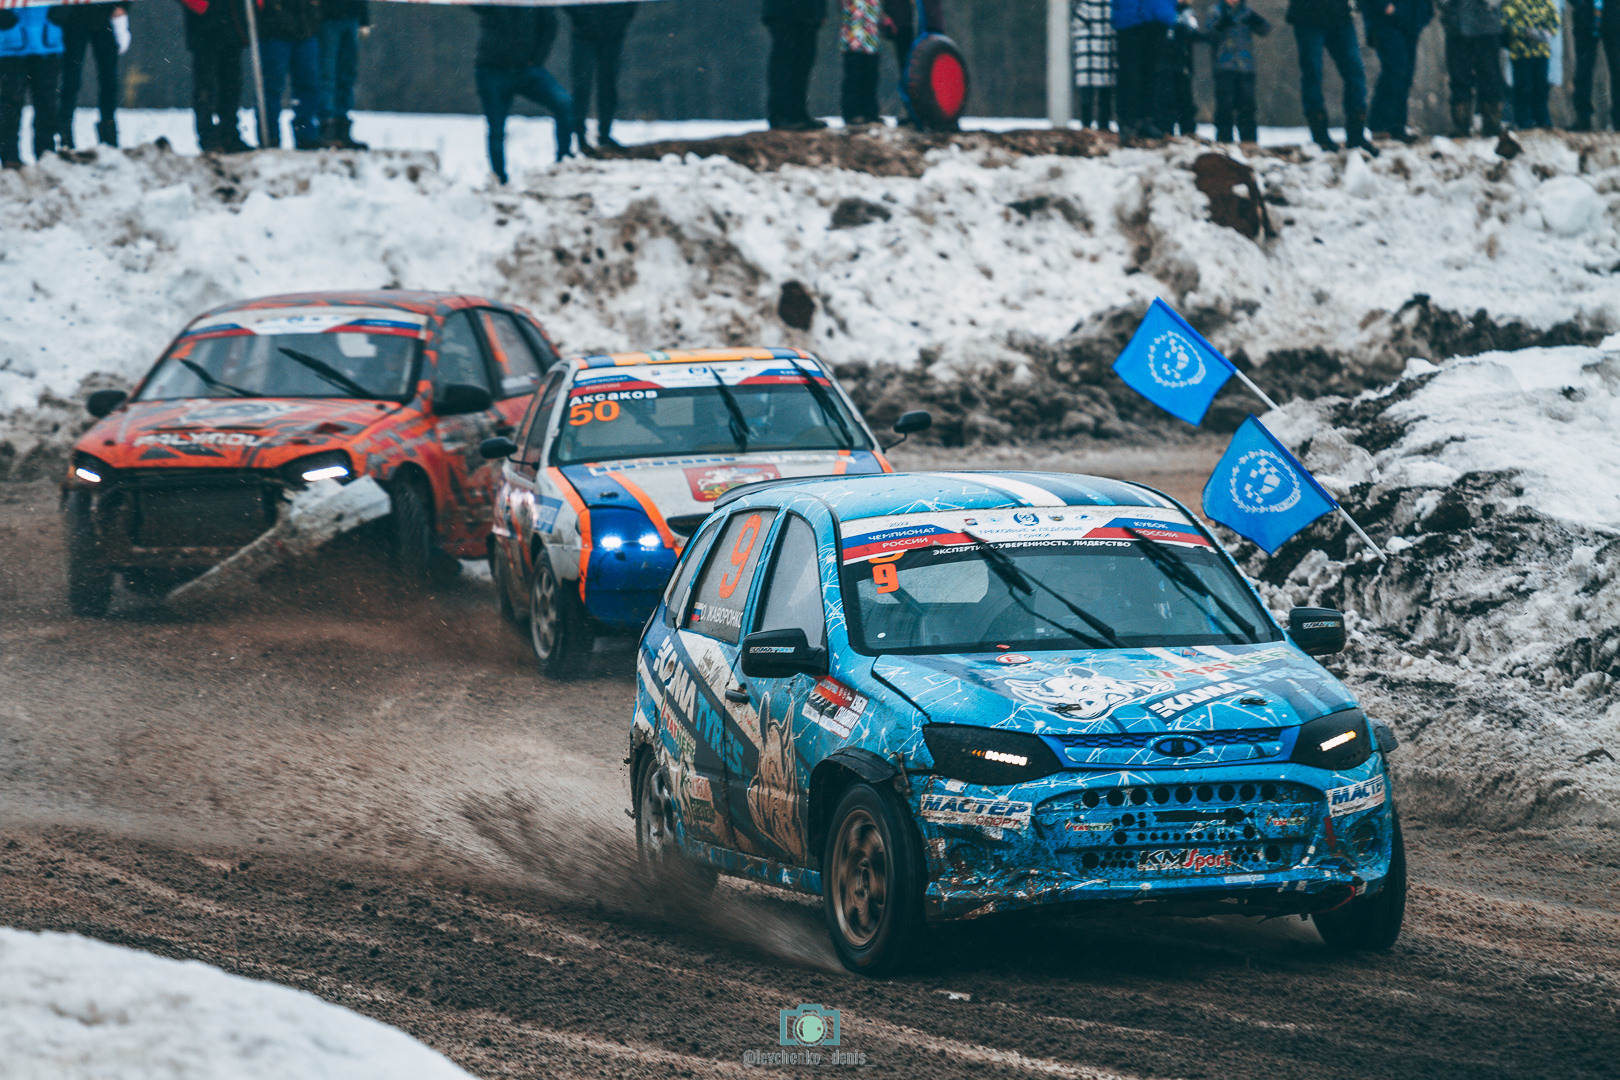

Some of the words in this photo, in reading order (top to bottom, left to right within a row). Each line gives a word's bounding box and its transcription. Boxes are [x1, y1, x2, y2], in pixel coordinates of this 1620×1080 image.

[569, 400, 620, 427] 50
[1133, 520, 1169, 530] КУБОК
[868, 526, 936, 541] ЧЕМПИОНАТ
[881, 536, 929, 549] РОССИИ
[1072, 540, 1132, 548] ЛИДЕРСТВО
[719, 514, 762, 599] 9
[872, 562, 900, 595] 9
[923, 795, 1030, 817] МАСТЕР
[975, 815, 1022, 828] СПОРТ
